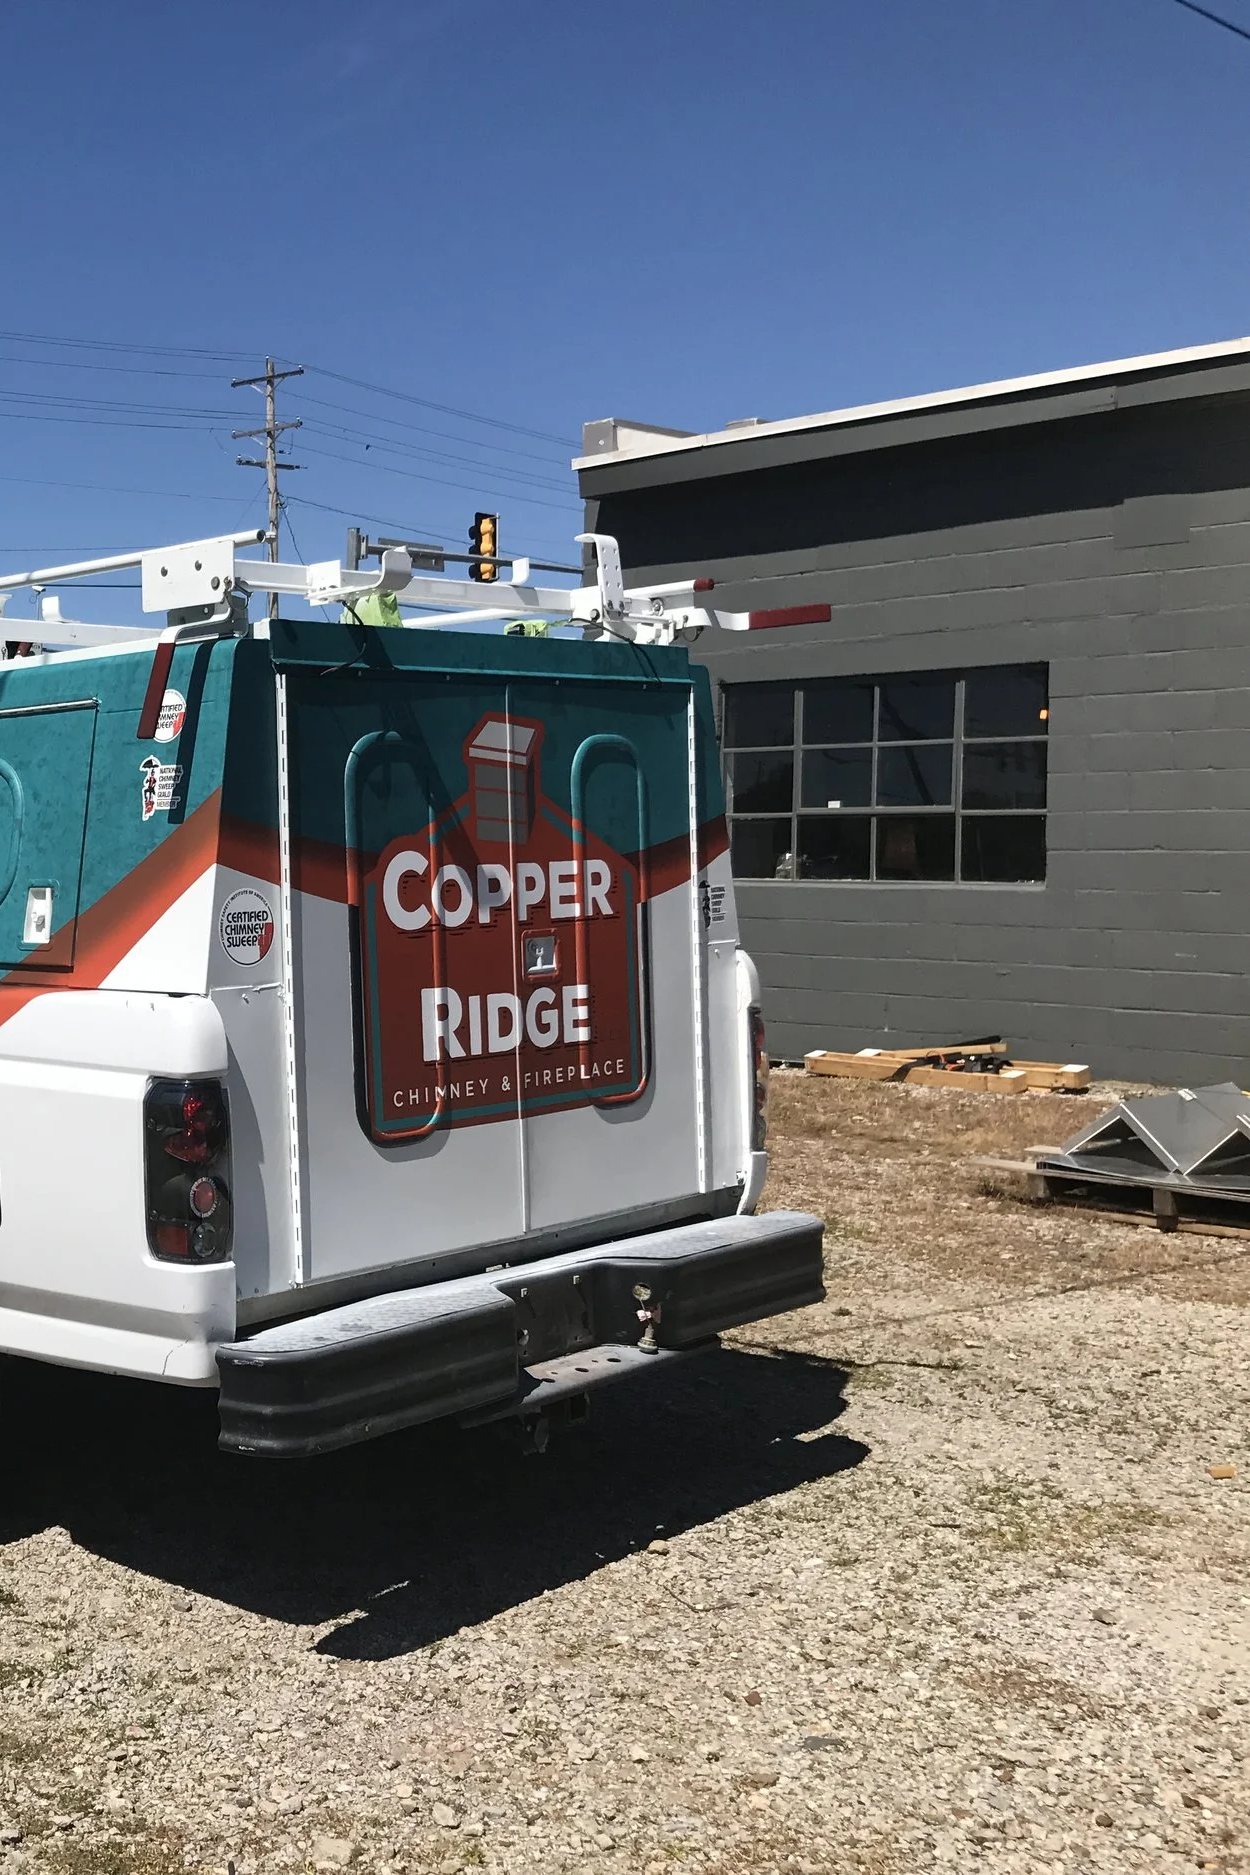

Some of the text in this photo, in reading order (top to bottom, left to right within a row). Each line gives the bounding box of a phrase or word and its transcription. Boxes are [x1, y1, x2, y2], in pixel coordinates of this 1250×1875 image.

[383, 850, 614, 930] COPPER
[225, 923, 264, 936] CHIMNEY
[227, 911, 268, 923] CERTIFIED
[421, 984, 592, 1063] RIDGE
[393, 1058, 625, 1107] CHIMNEY & FIREPLACE
